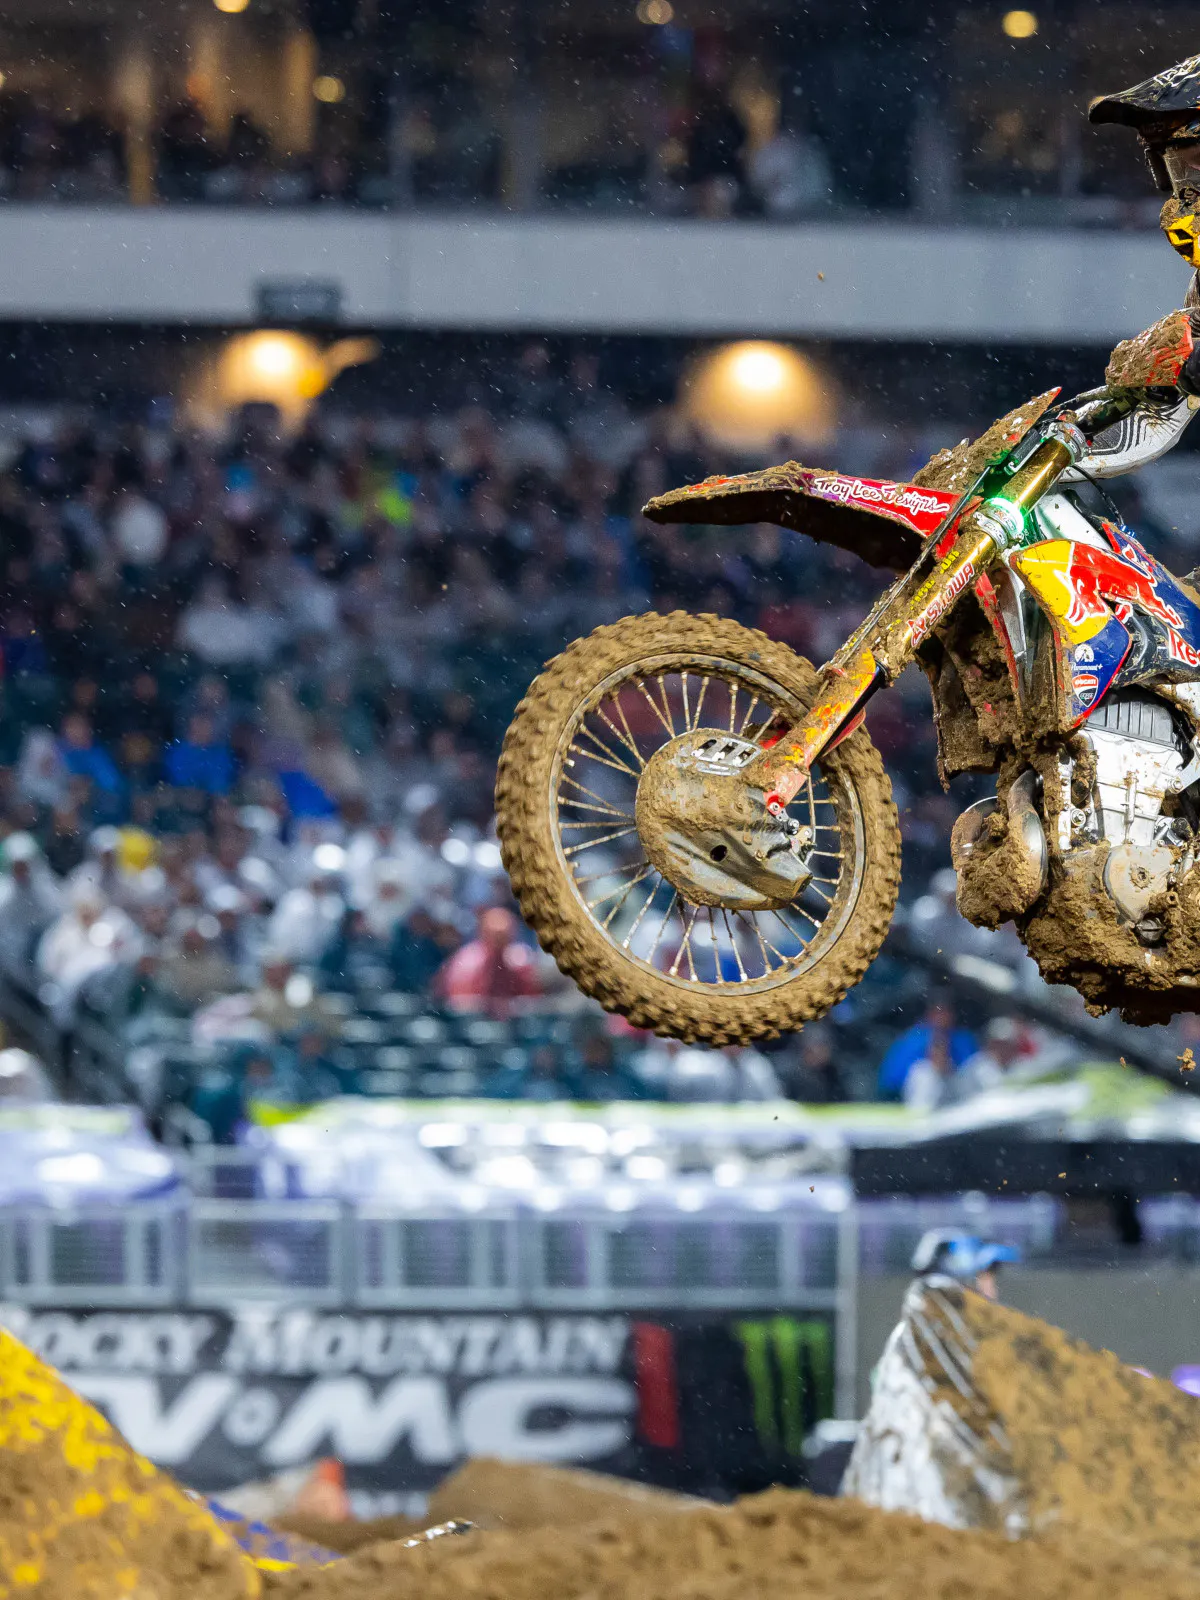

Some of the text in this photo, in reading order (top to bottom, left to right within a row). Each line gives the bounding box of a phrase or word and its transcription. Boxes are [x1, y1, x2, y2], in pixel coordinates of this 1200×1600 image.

[815, 477, 950, 515] Troy Lee Designs
